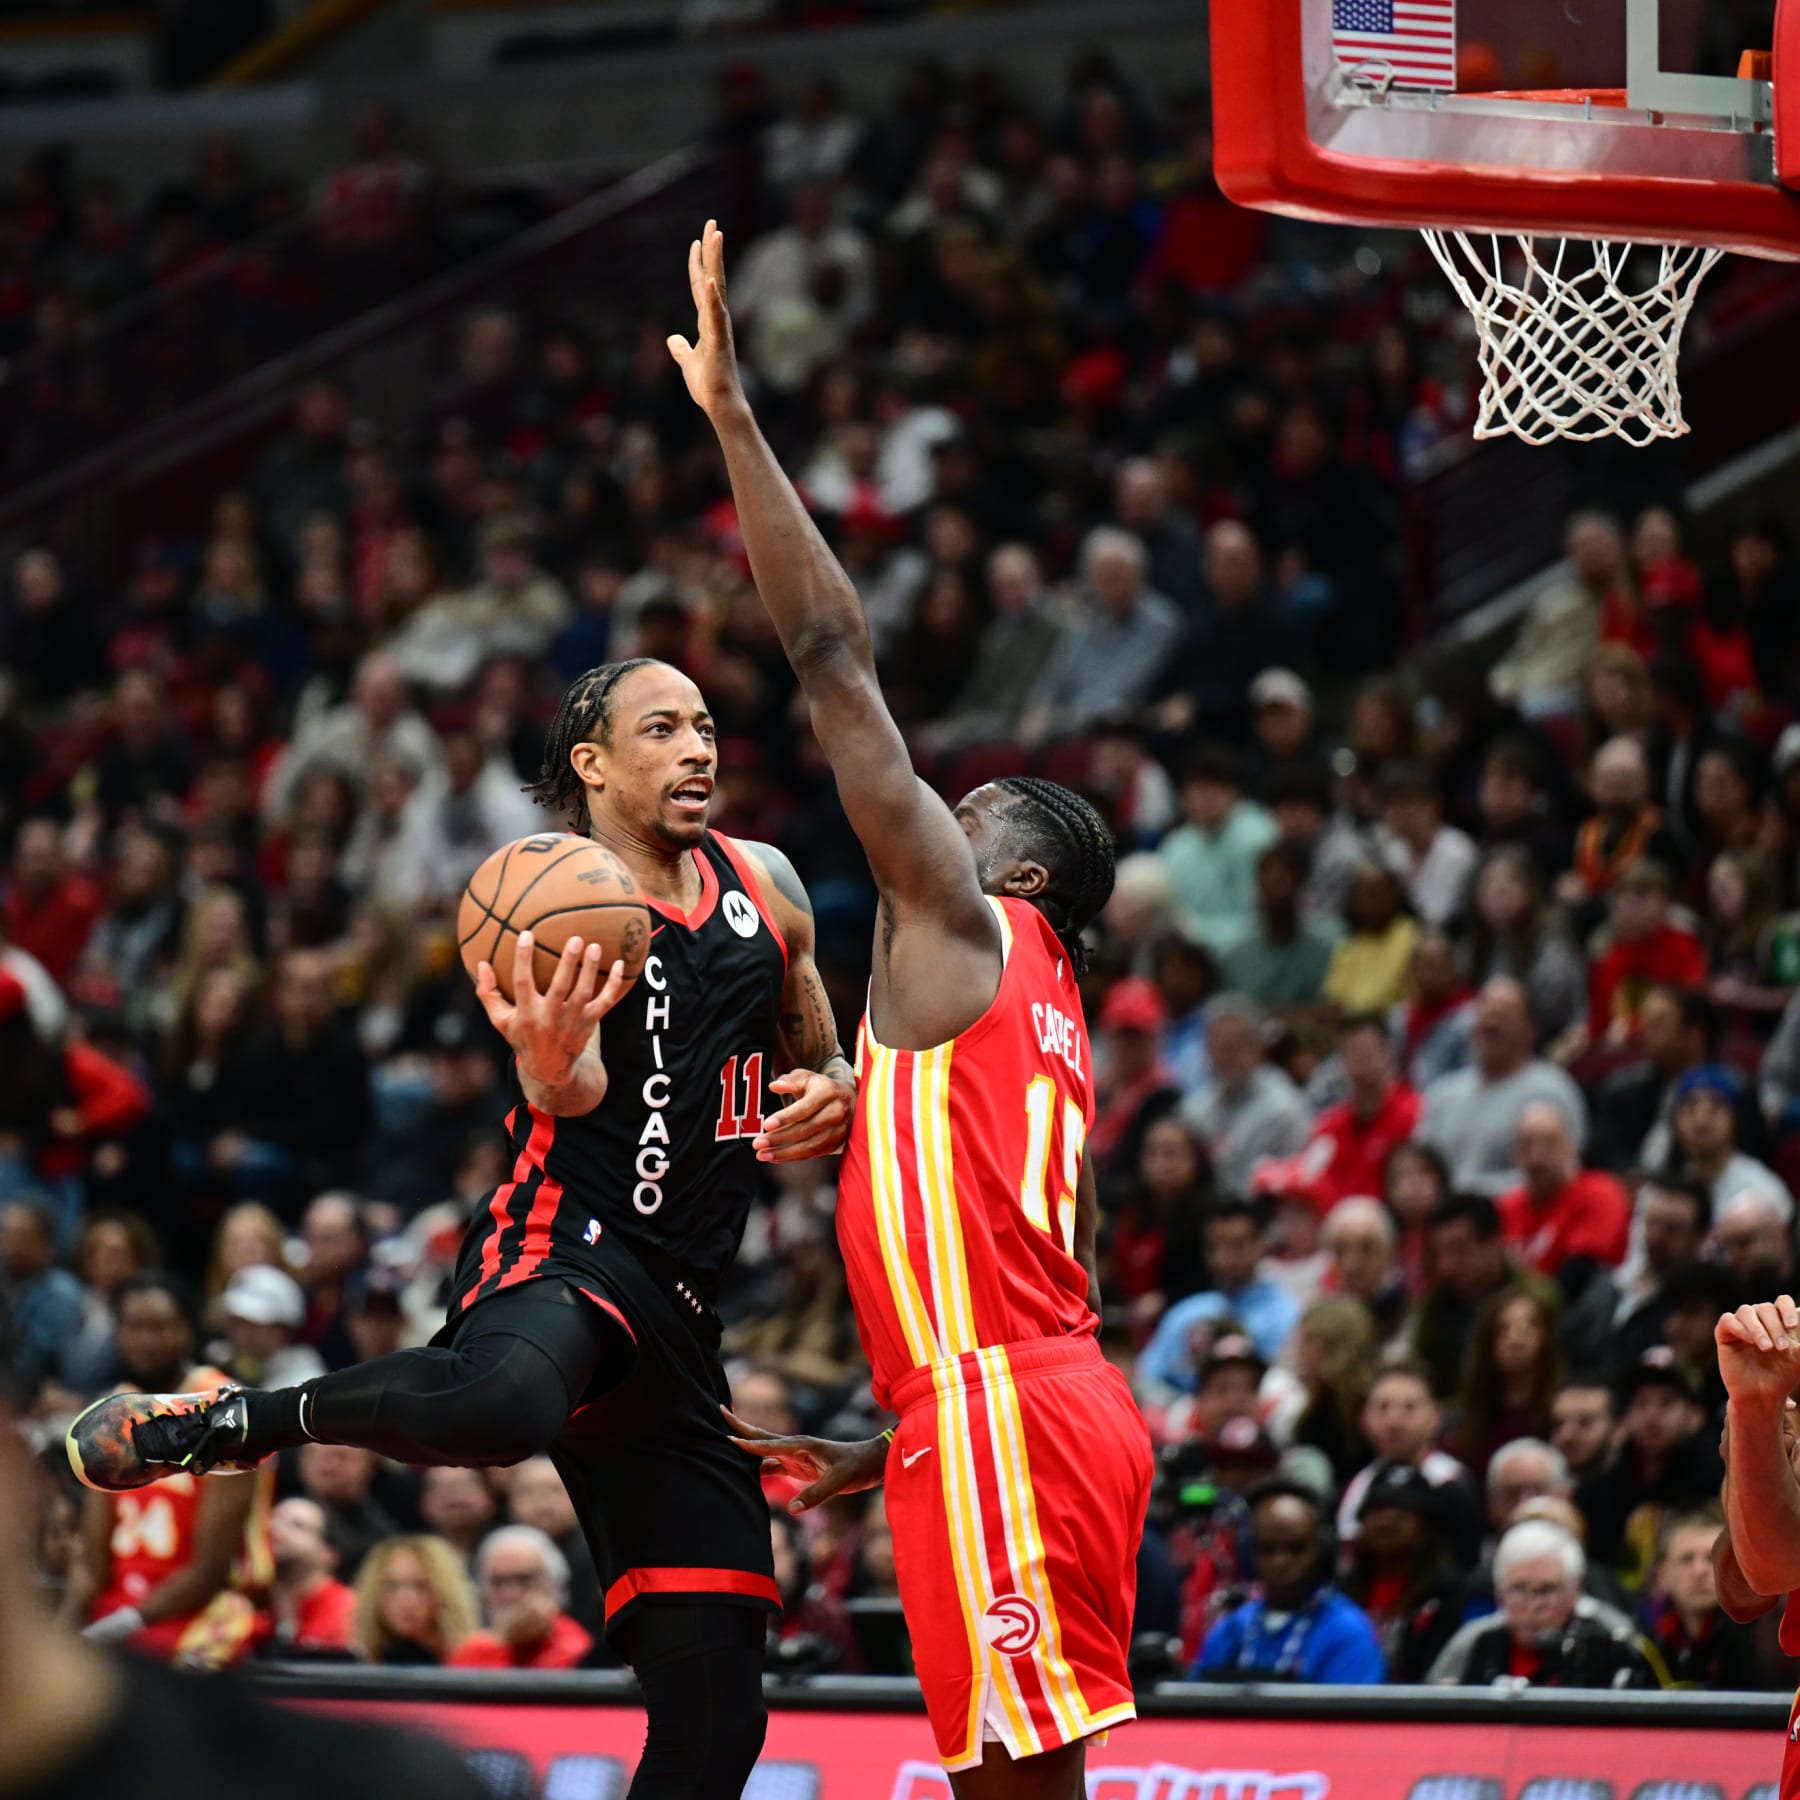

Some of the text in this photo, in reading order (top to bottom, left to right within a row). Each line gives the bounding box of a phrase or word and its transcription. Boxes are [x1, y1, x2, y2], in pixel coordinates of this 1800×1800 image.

[632, 955, 673, 1216] CHICAGO
[714, 1051, 765, 1143] 11
[1020, 1072, 1087, 1260] 15
